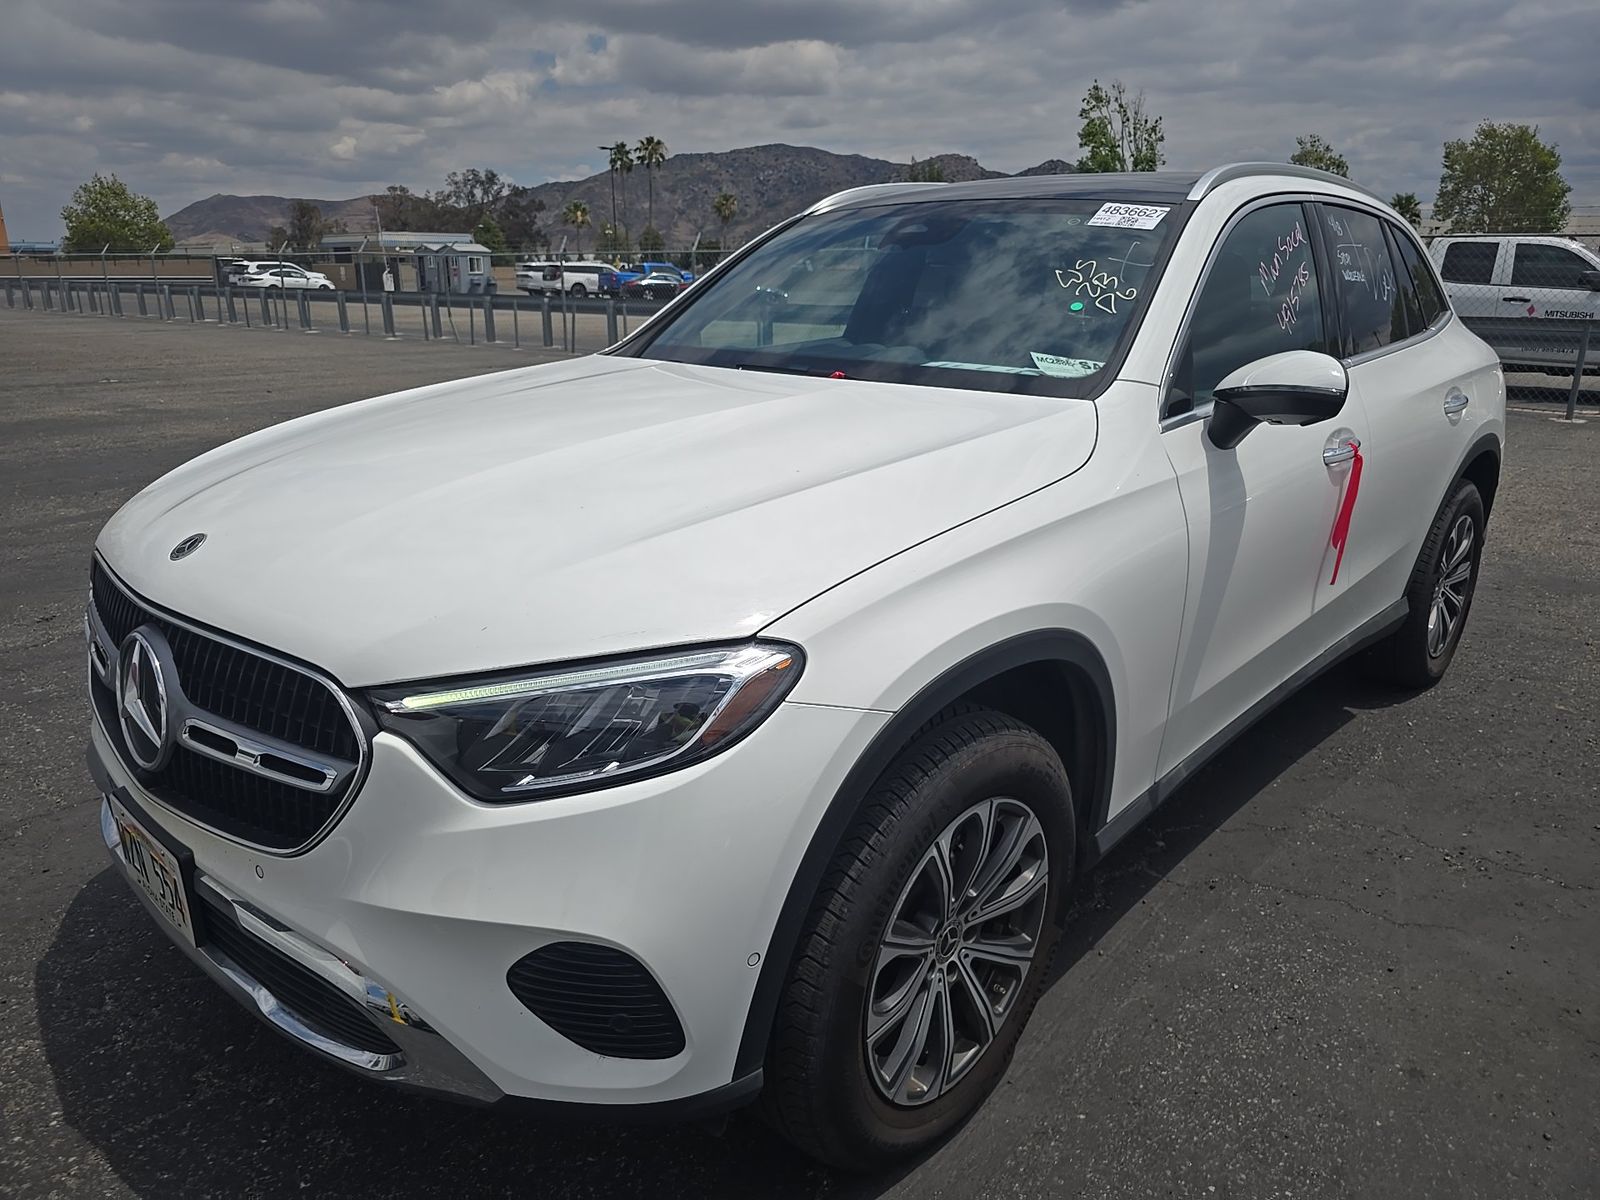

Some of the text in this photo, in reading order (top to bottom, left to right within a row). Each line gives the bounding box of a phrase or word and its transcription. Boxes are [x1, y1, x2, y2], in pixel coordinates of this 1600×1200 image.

[1101, 205, 1168, 218] 4836627
[1544, 310, 1594, 319] MITSUBISHI
[150, 851, 187, 927] 554
